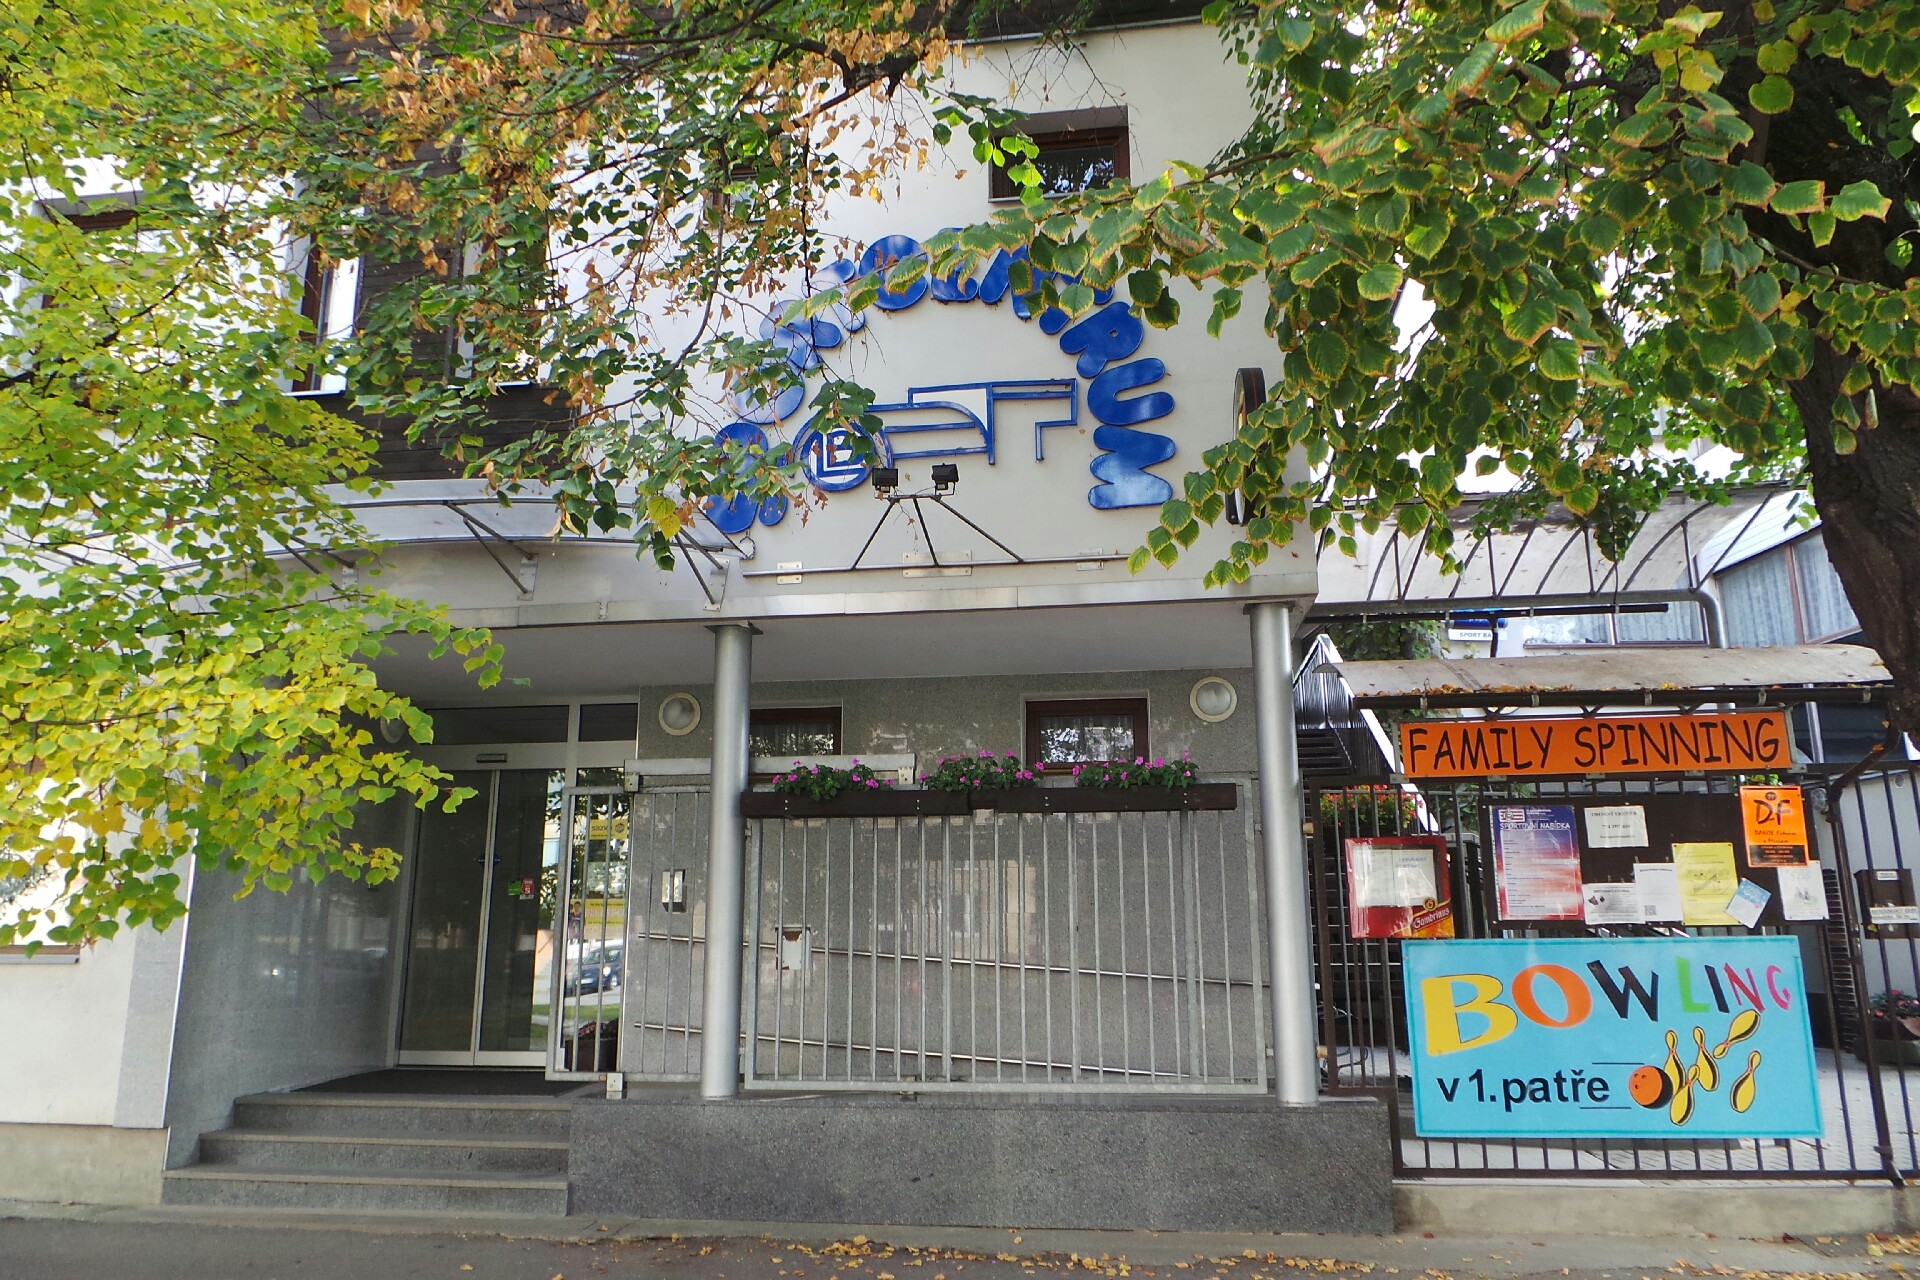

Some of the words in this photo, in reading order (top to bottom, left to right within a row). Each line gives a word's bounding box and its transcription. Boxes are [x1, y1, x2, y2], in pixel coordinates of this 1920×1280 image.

[1409, 726, 1553, 773] FAMILY
[1574, 718, 1780, 767] SPINNING
[1413, 907, 1450, 929] Gambrinus
[1421, 956, 1792, 1056] BOWLING
